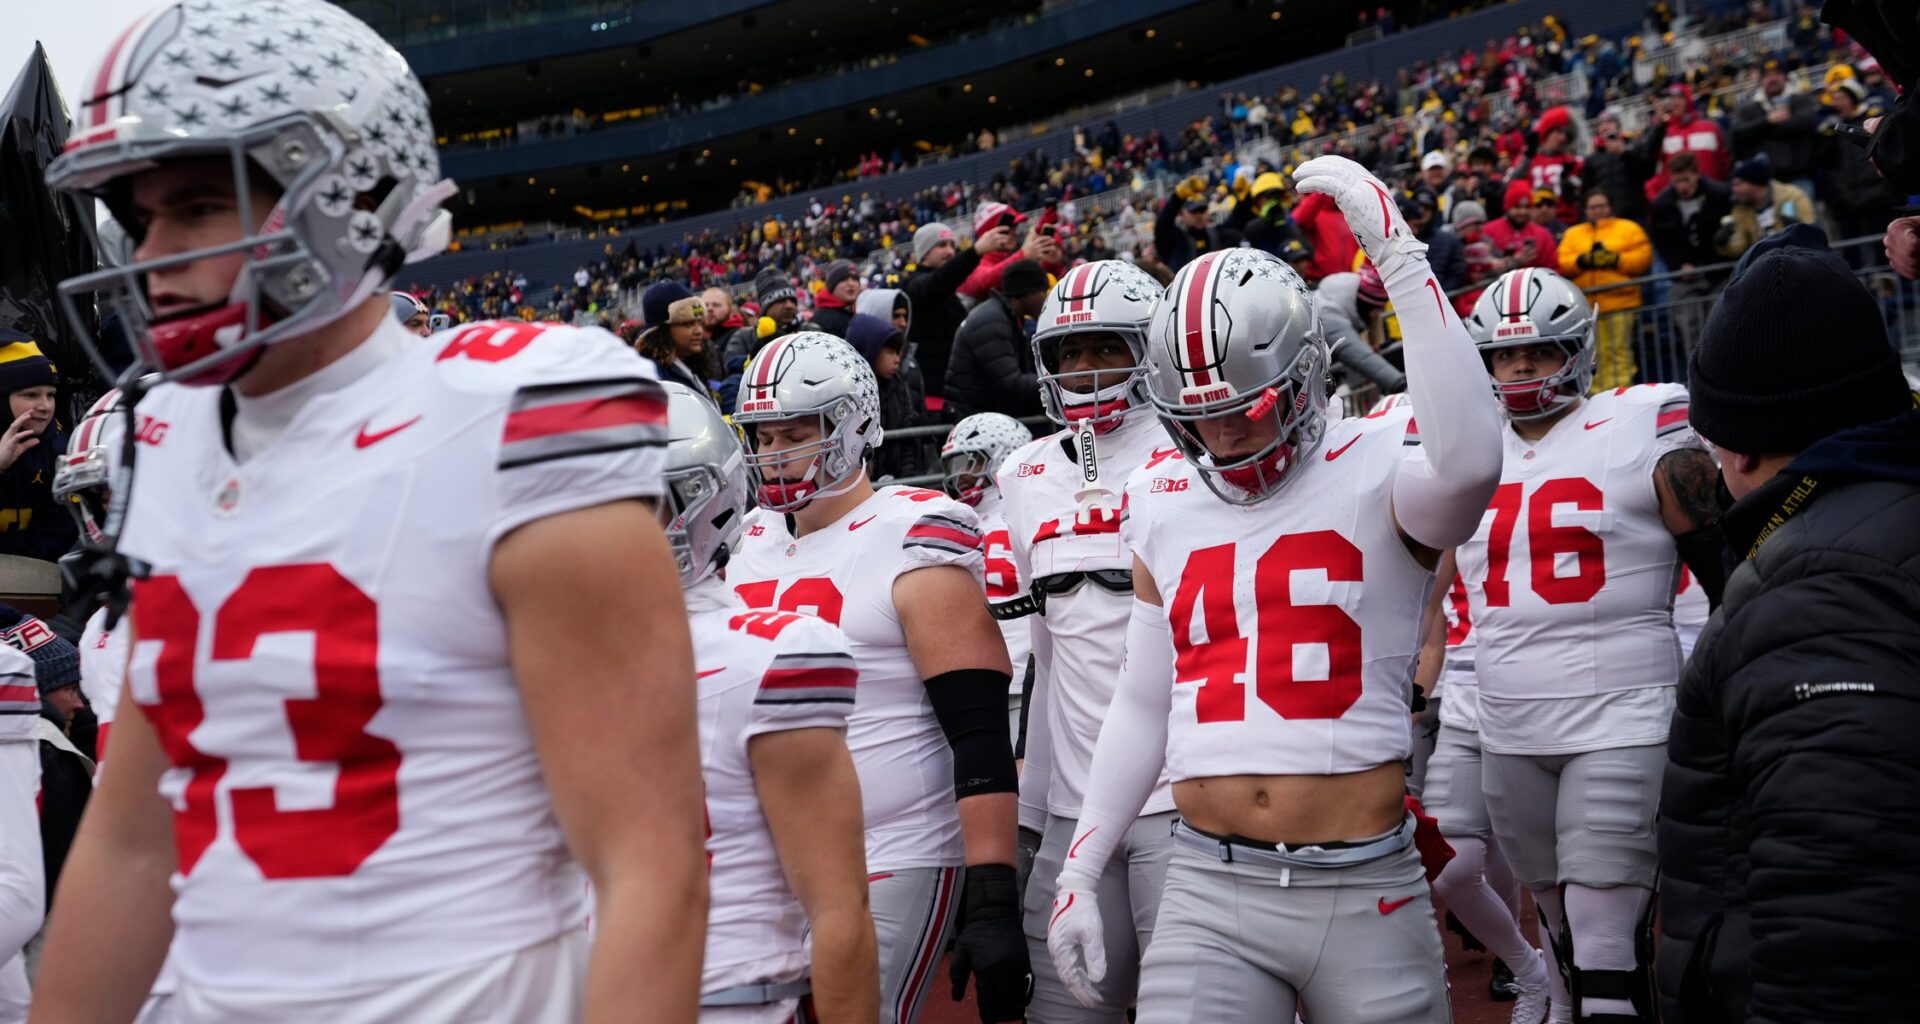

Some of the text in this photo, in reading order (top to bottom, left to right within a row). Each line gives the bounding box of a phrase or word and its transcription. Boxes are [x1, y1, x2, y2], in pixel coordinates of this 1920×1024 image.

[1056, 312, 1092, 325] OHIO STATE
[1497, 326, 1533, 337] OHIO STATE
[1183, 387, 1230, 405] OHIO STATE
[743, 401, 774, 412] OHIO STATE
[1083, 436, 1095, 478] BATTLE
[1018, 463, 1045, 478] BIG
[1151, 478, 1189, 493] BIG
[1782, 475, 1818, 515] ATHLE
[1483, 477, 1606, 607] 76
[1169, 529, 1364, 724] 46
